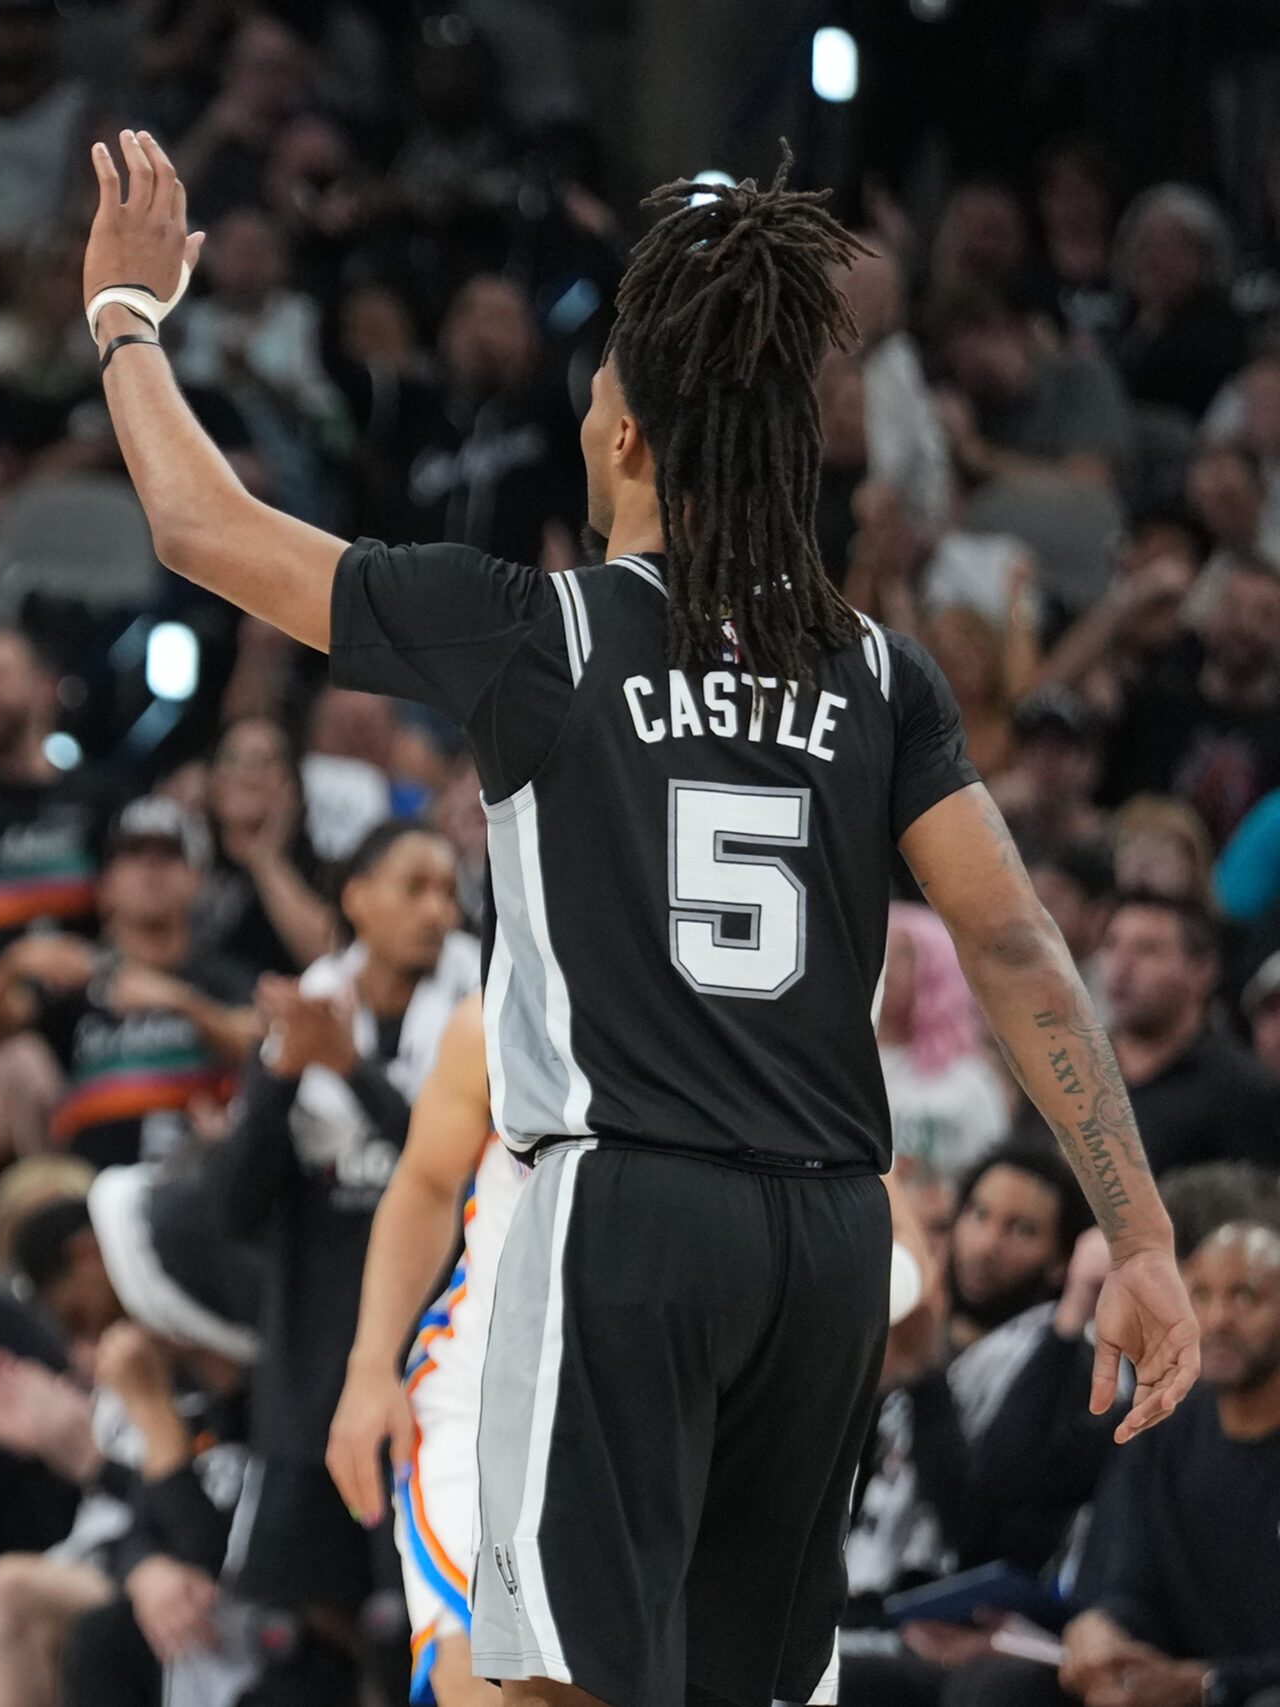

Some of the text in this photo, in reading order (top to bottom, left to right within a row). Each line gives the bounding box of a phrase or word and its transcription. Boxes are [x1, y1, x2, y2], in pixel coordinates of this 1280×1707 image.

[623, 669, 848, 762] CASTLE
[667, 778, 811, 1000] 5
[1048, 1047, 1085, 1096] XXV
